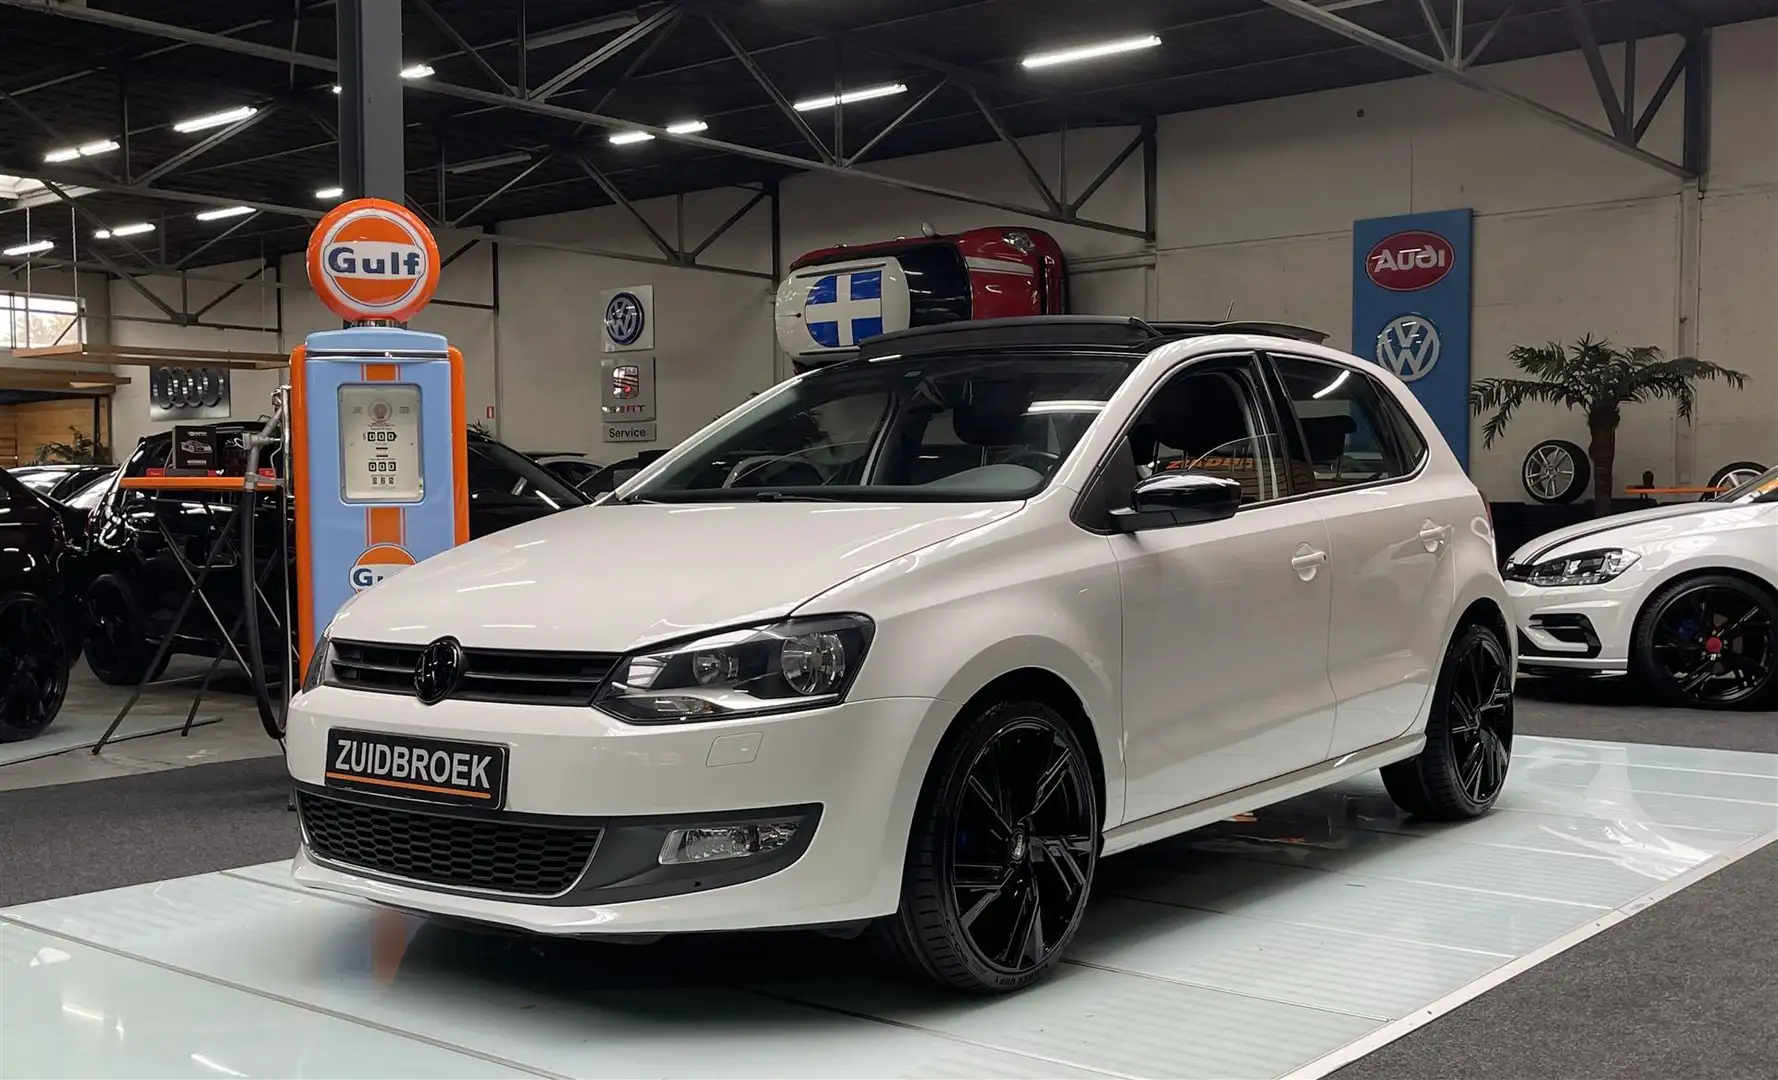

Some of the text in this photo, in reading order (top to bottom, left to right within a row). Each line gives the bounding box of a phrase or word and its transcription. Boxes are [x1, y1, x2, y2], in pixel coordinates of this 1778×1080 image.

[328, 247, 420, 276] Gulf
[609, 427, 646, 438] Service
[335, 739, 492, 789] ZUIDBROEK
